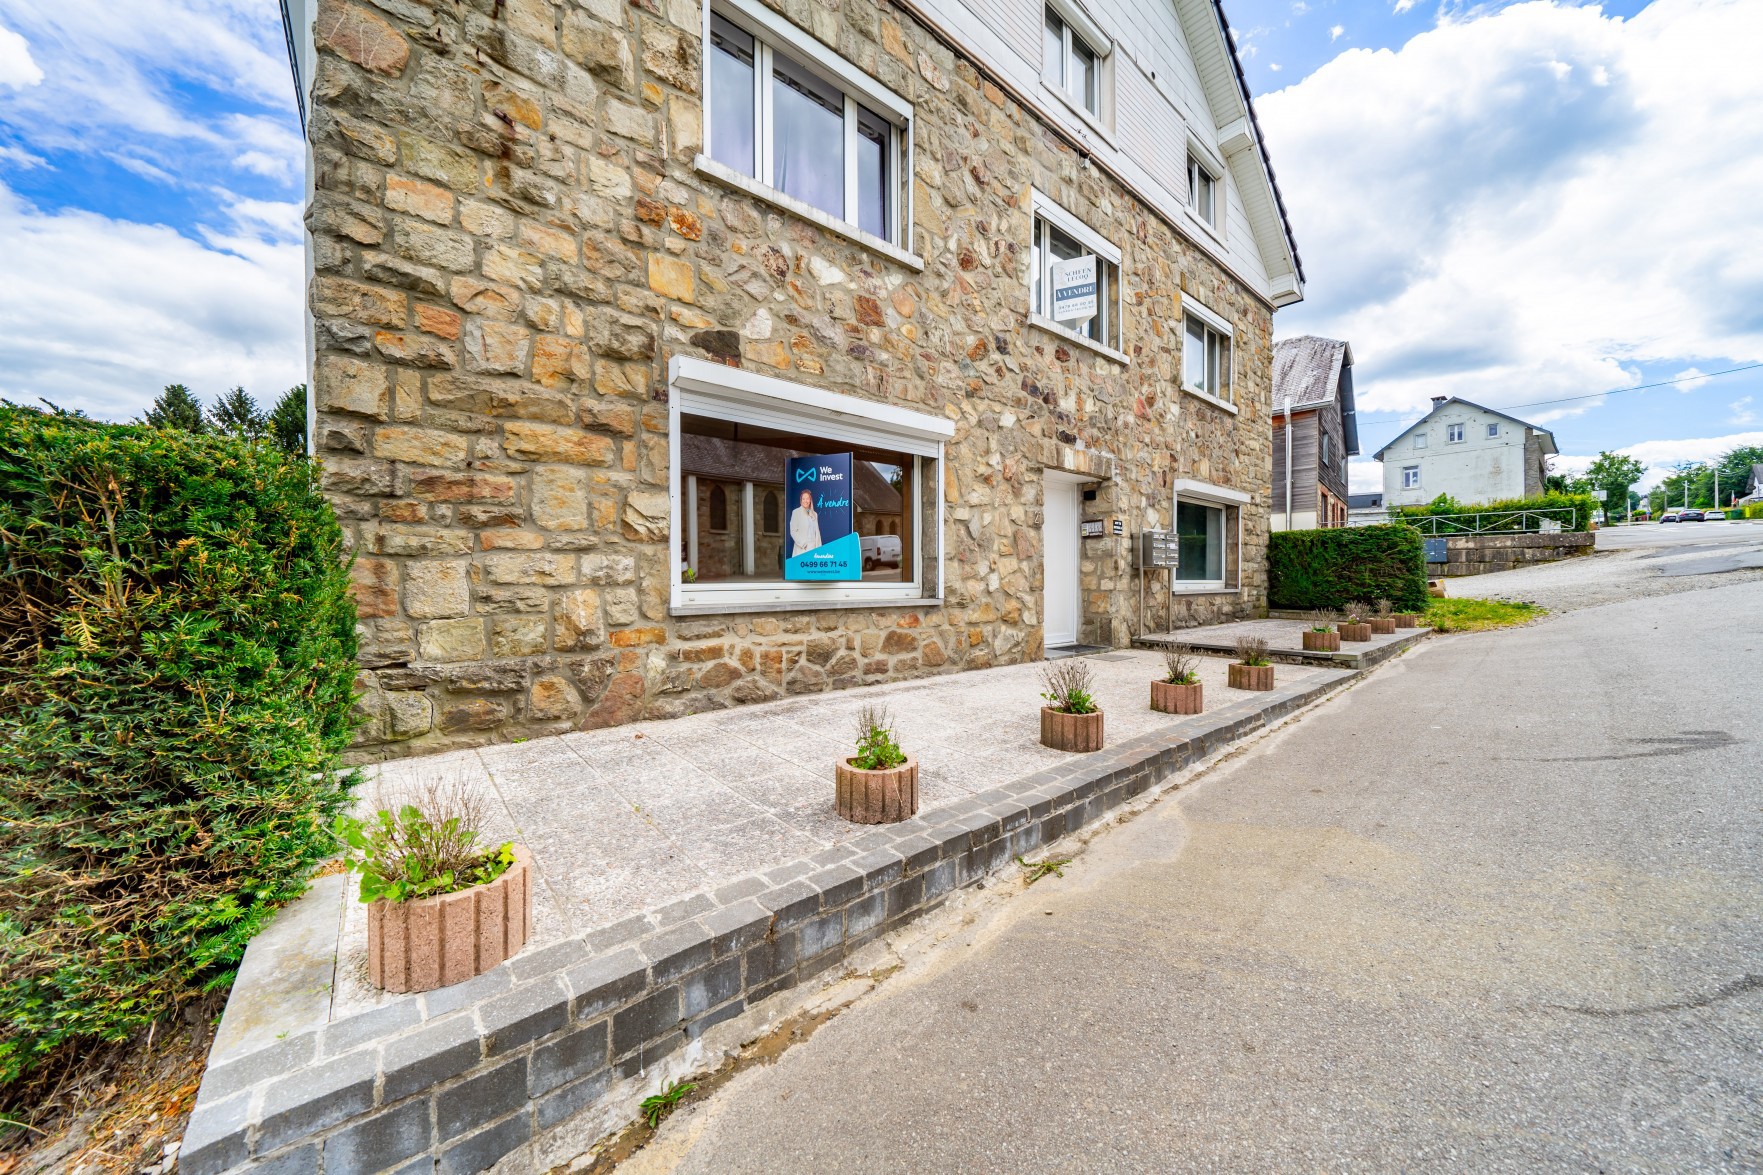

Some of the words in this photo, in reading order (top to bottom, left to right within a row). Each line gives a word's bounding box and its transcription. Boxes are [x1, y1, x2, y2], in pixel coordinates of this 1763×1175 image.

[1062, 285, 1095, 297] VENDRE
[819, 466, 832, 474] We
[819, 473, 843, 481] Invest
[825, 497, 849, 508] vendre
